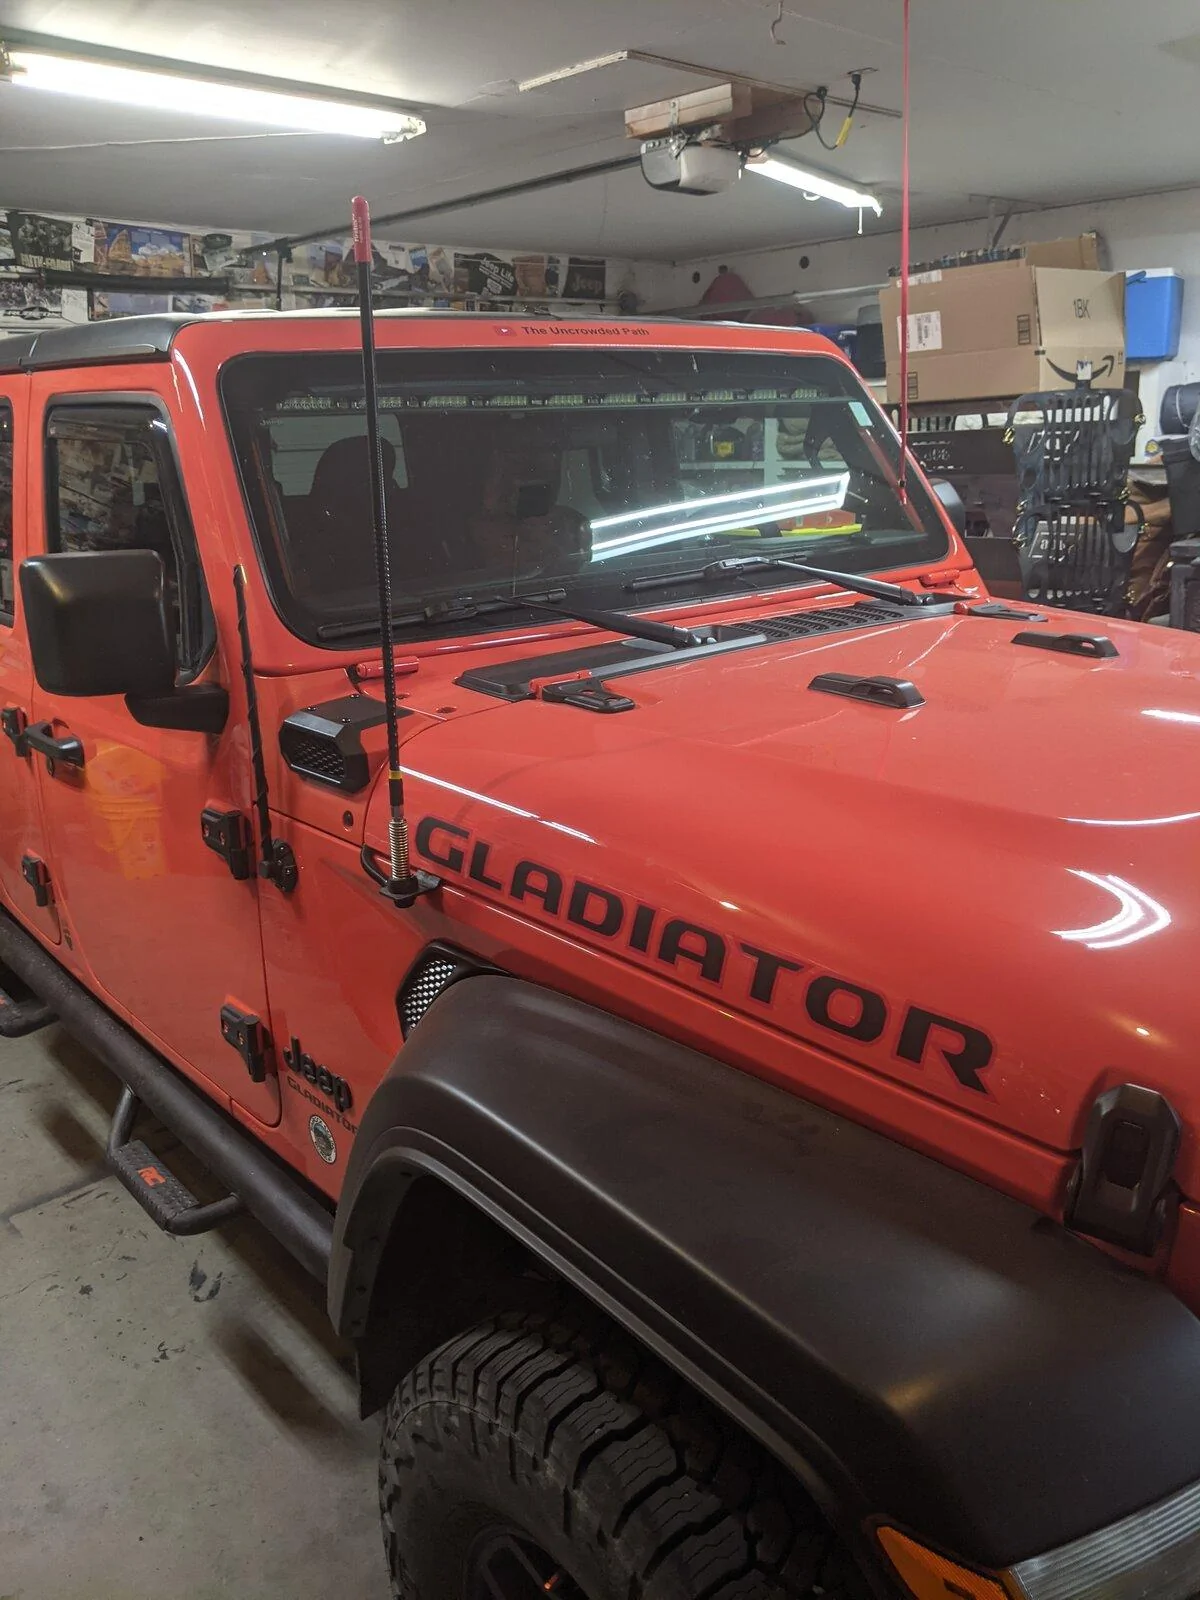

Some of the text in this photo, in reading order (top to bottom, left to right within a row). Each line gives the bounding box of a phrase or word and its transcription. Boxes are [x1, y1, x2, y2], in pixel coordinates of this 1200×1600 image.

[570, 273, 603, 294] Jeep
[521, 326, 650, 336] The Uncrowded Path
[415, 816, 994, 1095] GLADIATOR
[283, 1035, 353, 1112] Jeep
